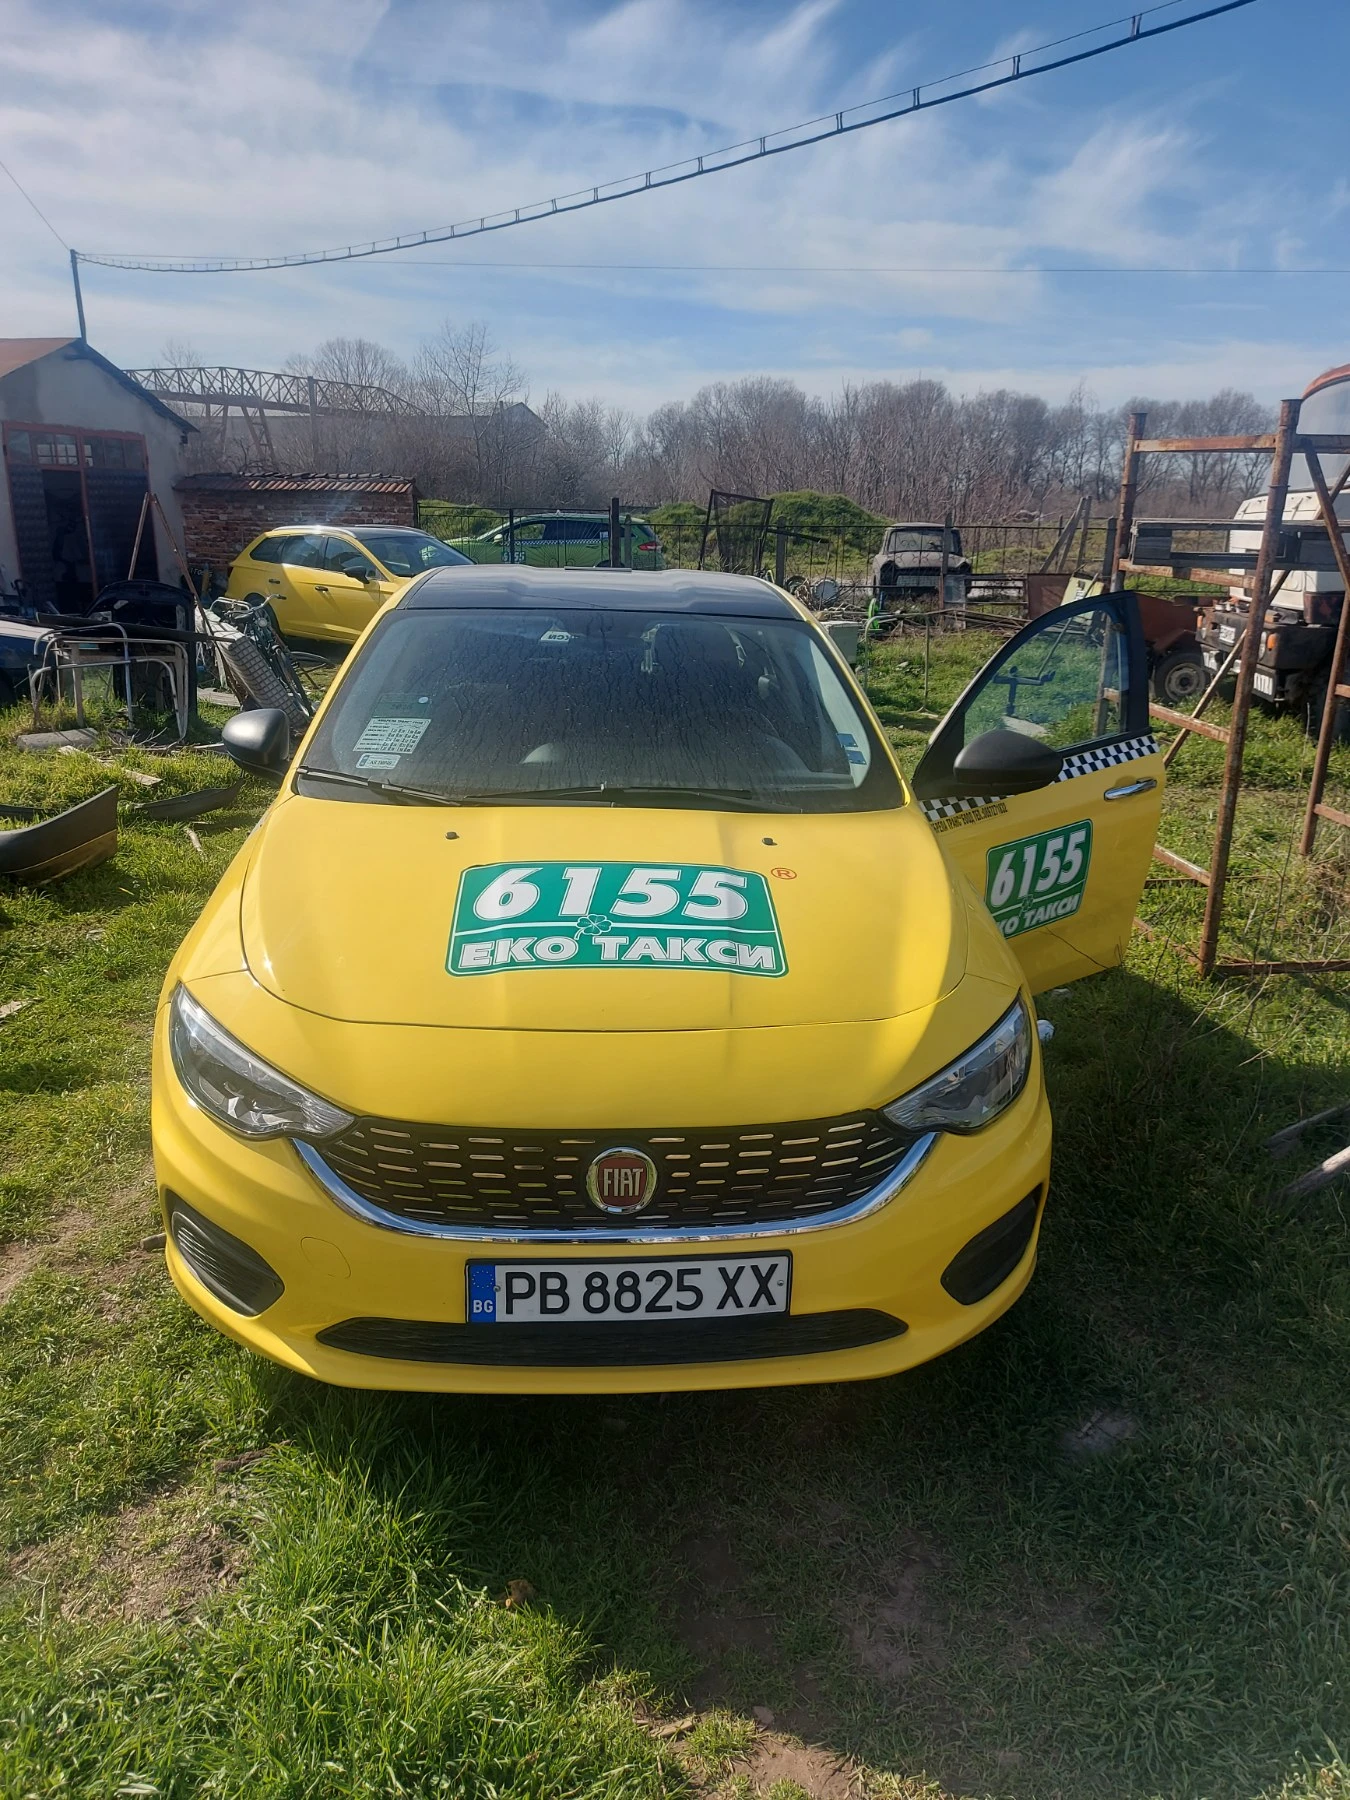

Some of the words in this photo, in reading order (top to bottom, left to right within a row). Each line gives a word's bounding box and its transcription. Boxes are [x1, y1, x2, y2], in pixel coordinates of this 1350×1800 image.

[990, 829, 1087, 908] 6155
[473, 867, 749, 922] 6155
[1024, 894, 1081, 926] ТАКСИ
[458, 936, 579, 969] ЕКО
[592, 936, 778, 970] ТАКСИ
[603, 1167, 644, 1197] FIAT
[472, 1299, 494, 1313] BG
[582, 1268, 703, 1314] 8825
